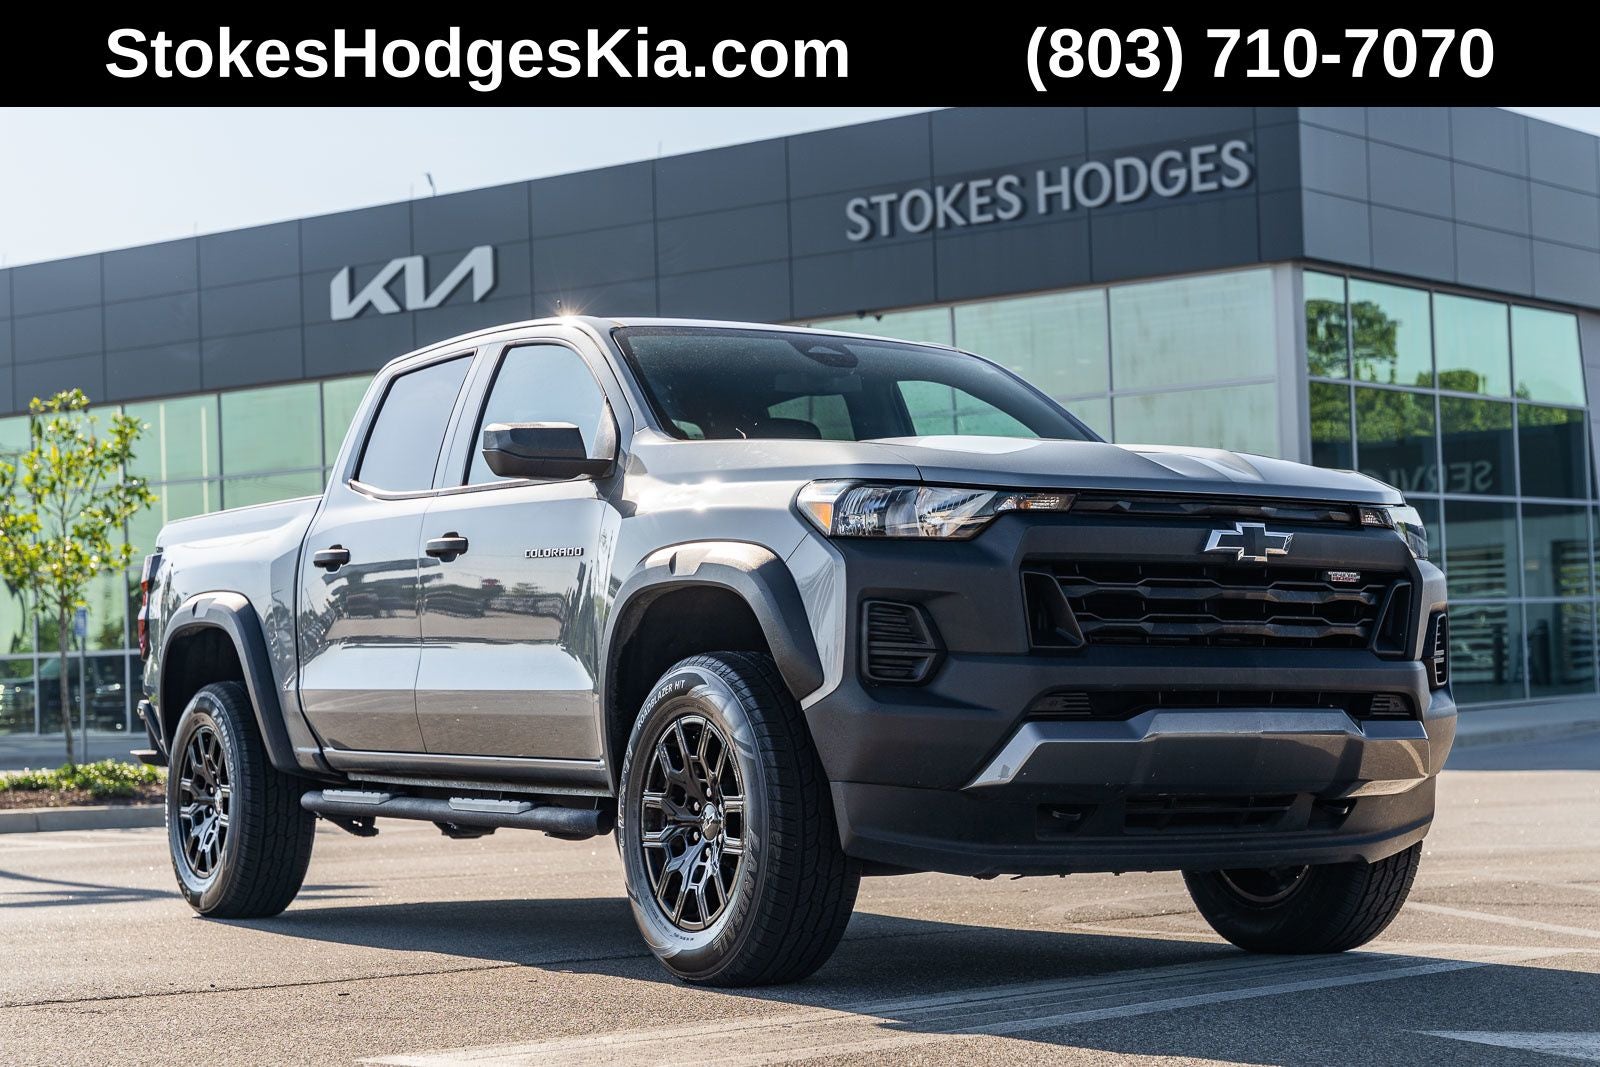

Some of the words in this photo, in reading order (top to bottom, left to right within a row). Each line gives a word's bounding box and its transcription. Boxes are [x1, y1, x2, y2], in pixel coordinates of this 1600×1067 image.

[845, 174, 1024, 242] STOKES
[1036, 139, 1252, 214] HODGES
[330, 244, 495, 321] KIA
[524, 546, 584, 558] COLORADO
